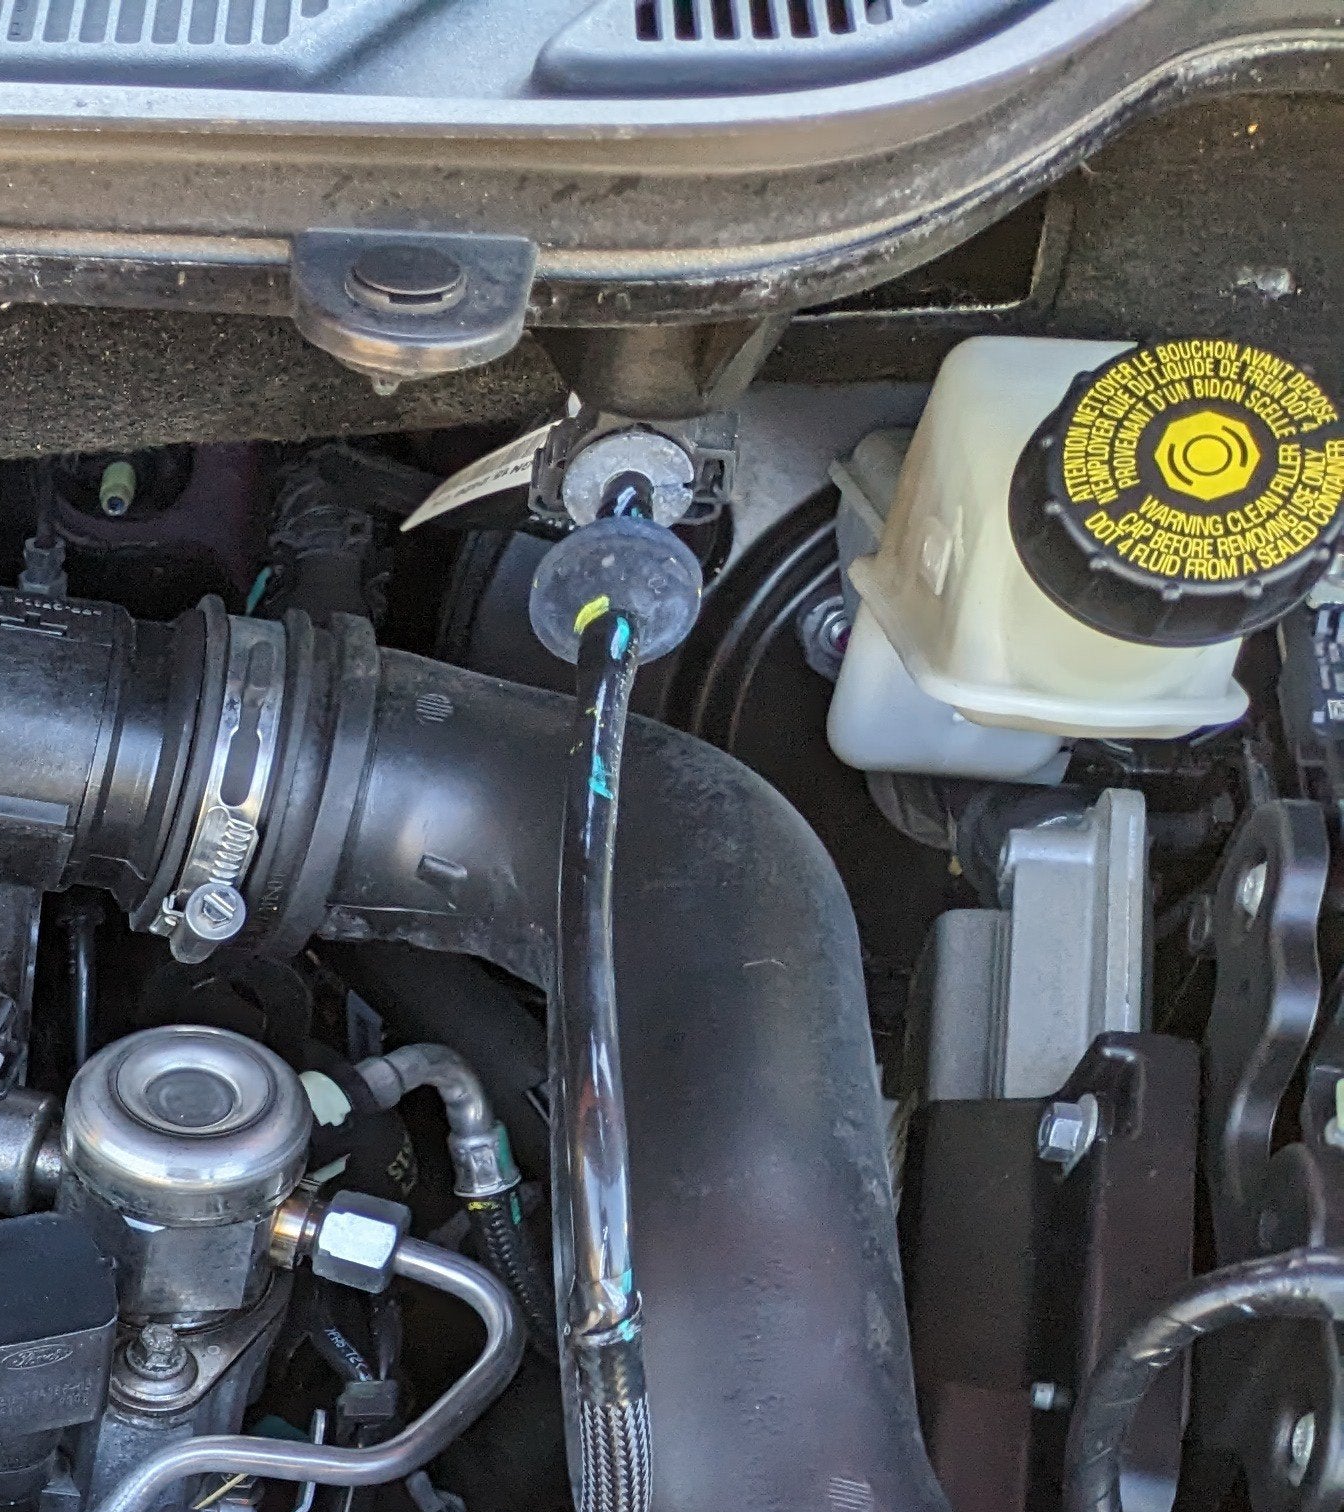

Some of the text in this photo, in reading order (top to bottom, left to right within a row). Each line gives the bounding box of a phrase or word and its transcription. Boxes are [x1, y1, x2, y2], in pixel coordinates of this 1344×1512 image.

[1063, 341, 1338, 503] ATTENTION NETTOYER LE BOUCHON AVANT DEPOSE
[1087, 359, 1322, 505] N'EMPLOYER QUE DU LIQUIDE DE FREIN DOT 4
[1114, 379, 1297, 490] PROVENANT D'UN BIDON SCELLE
[1118, 449, 1326, 558] CAP BEFORE REMOVING USE ONLY
[1139, 443, 1301, 536] WARNING CLEAN FILLER
[1084, 511, 1124, 545] DOT
[1117, 535, 1134, 555] 4
[1129, 542, 1181, 576] FLUID
[1184, 557, 1237, 580] FROM
[1243, 554, 1257, 574] A
[1259, 520, 1318, 568] SEALED
